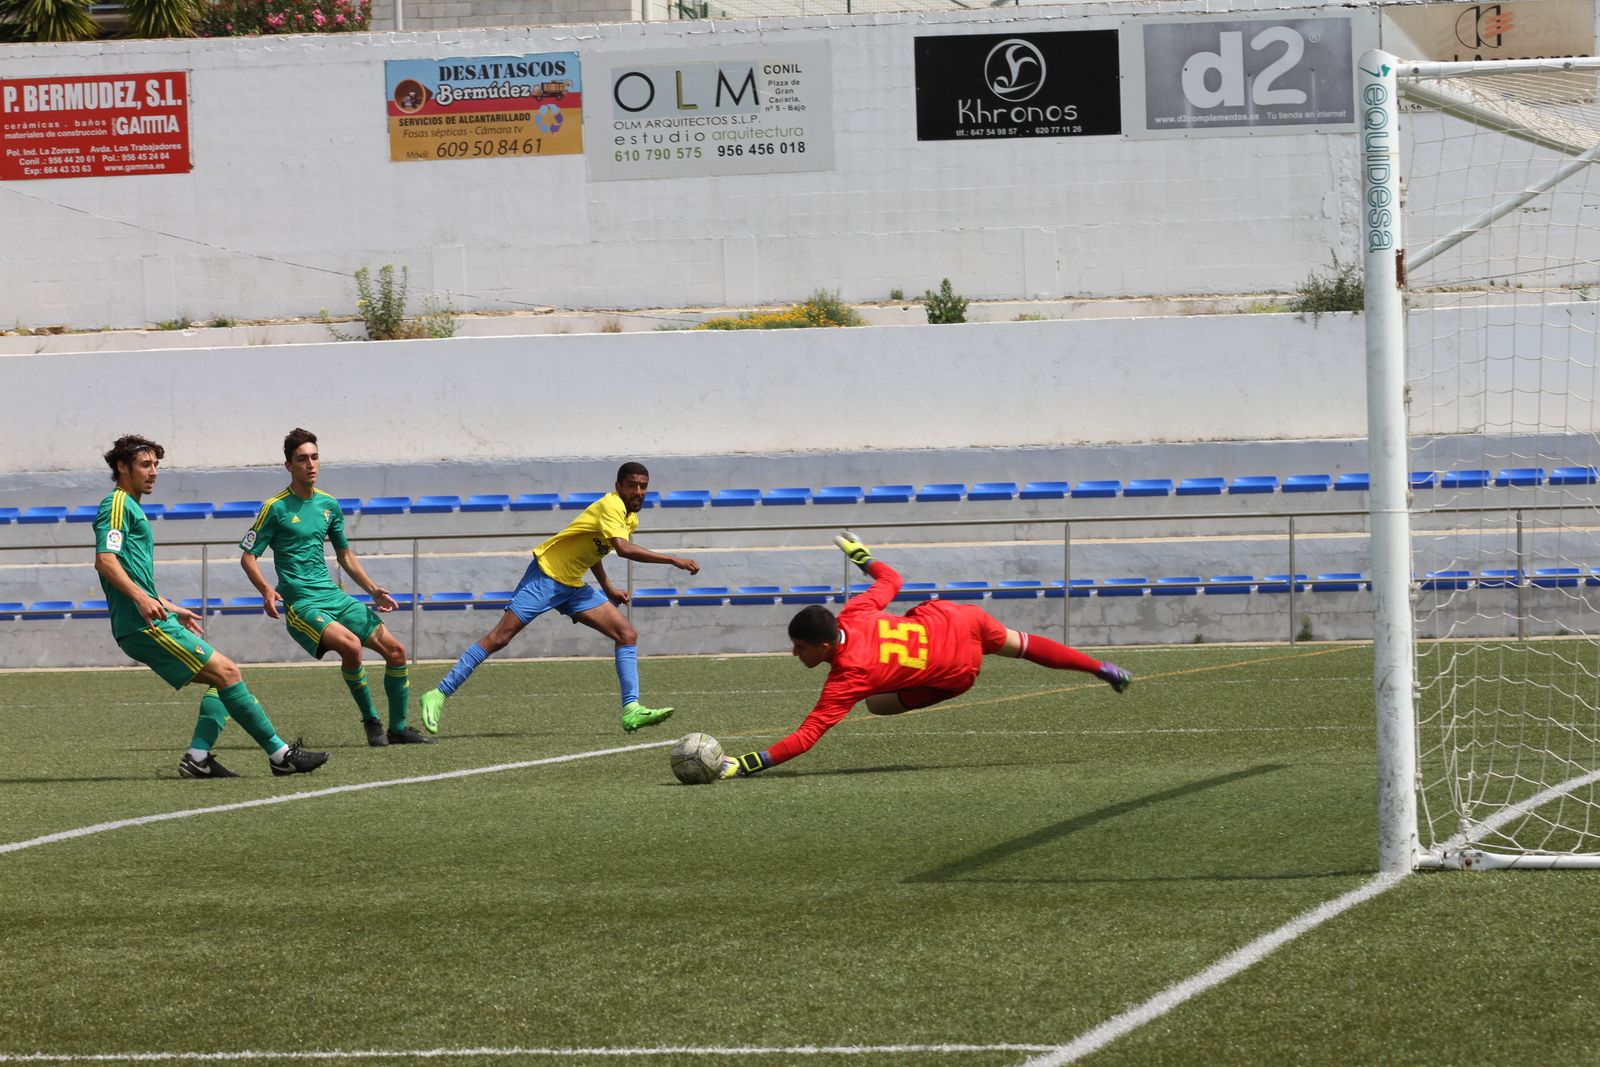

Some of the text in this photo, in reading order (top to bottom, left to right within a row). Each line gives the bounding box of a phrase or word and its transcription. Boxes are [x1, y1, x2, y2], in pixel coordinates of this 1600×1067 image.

[439, 60, 566, 82] DESATASCOS
[764, 64, 802, 75] CONIL
[1181, 26, 1308, 108] d2
[3, 79, 183, 113] P. BERMUDEZ, S.L.
[437, 82, 530, 105] Bermúdez
[958, 98, 1078, 124] Khronos
[1154, 112, 1260, 124] www.d2complementos.es
[75, 118, 108, 127] baños
[399, 113, 530, 126] SERVICIOS DE ALCANTARILLADO
[614, 114, 761, 130] OLM ARQUITECTOS S.L.P.
[4, 128, 108, 140] materiales de construcción
[403, 128, 430, 138] Fosas
[431, 127, 468, 139] sépticas
[475, 124, 510, 135] Cámara
[511, 126, 524, 134] tv
[614, 125, 804, 146] estudio arquitectura
[970, 128, 985, 136] 647
[6, 148, 22, 156] Pol.
[24, 148, 38, 156] Ind.
[51, 146, 80, 155] Zorrera
[90, 142, 182, 153] Avda. Los Trabajadores
[436, 138, 542, 158] 609 50 84 61
[615, 146, 702, 162] 610 790 575
[718, 141, 806, 157] 956 456 018
[19, 158, 40, 166] Conil
[122, 153, 136, 161] 956
[24, 166, 42, 175] Exp:
[60, 165, 69, 173] 43
[104, 163, 166, 172] www.gamma.es
[878, 620, 928, 670] 25
